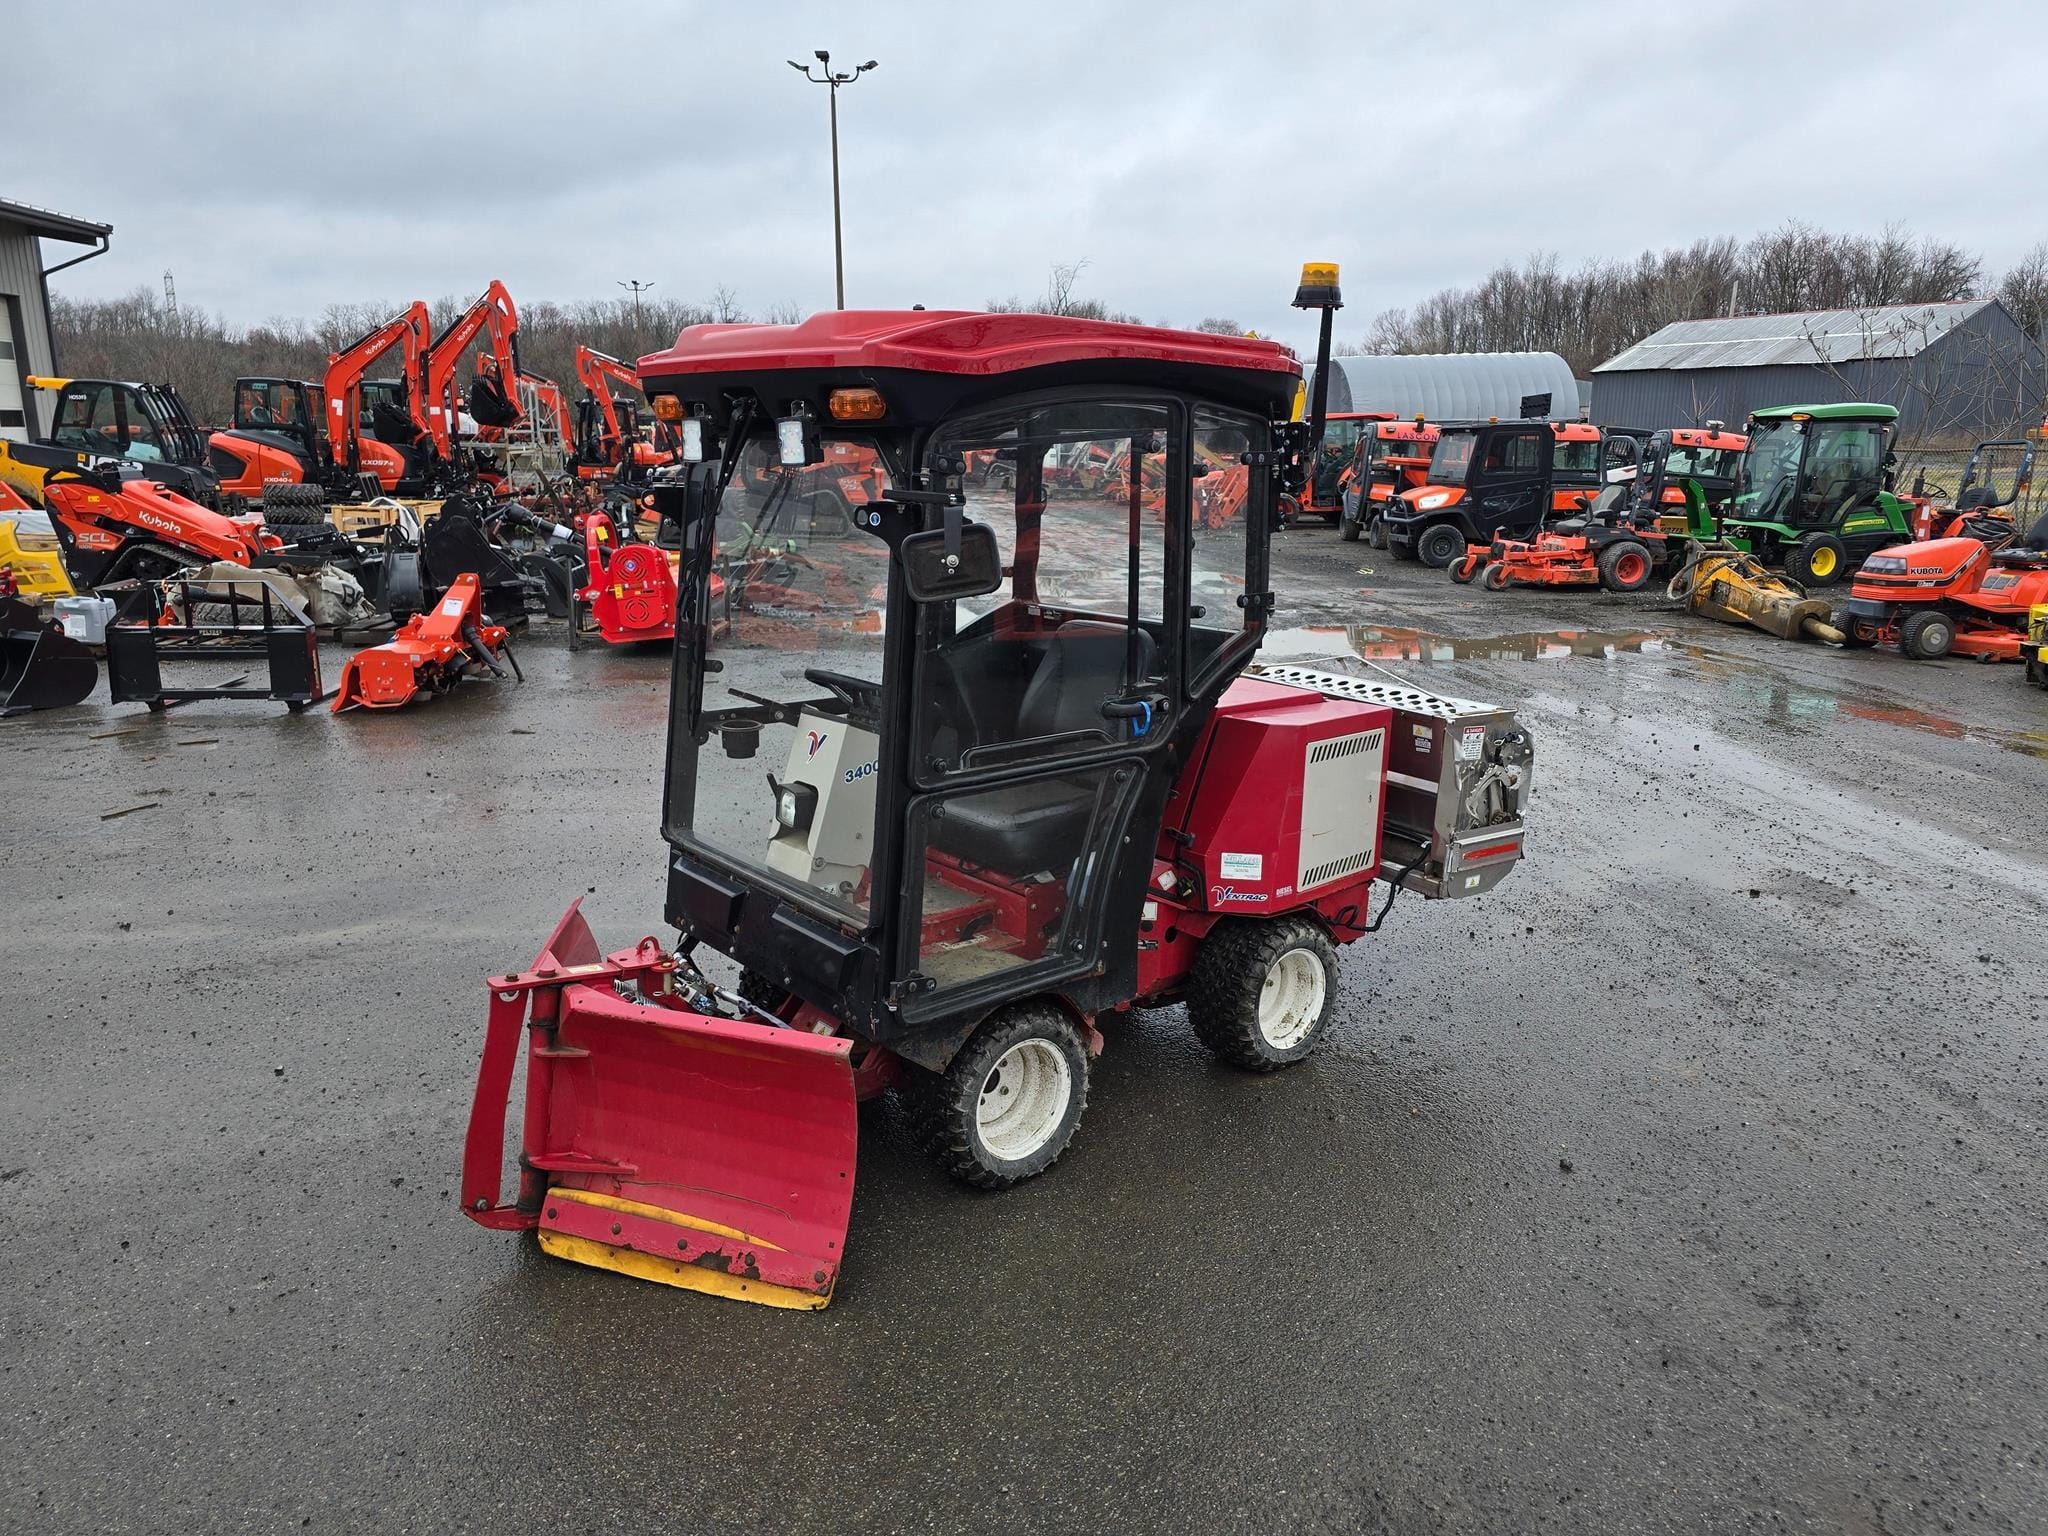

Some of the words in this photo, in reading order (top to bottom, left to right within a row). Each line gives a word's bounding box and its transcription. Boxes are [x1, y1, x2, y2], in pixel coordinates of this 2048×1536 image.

[1397, 432, 1438, 441] LASCON
[138, 510, 181, 534] Kubota
[78, 532, 110, 542] SCL
[1909, 567, 1943, 575] KUBOTA
[1211, 886, 1268, 906] VENTRAC
